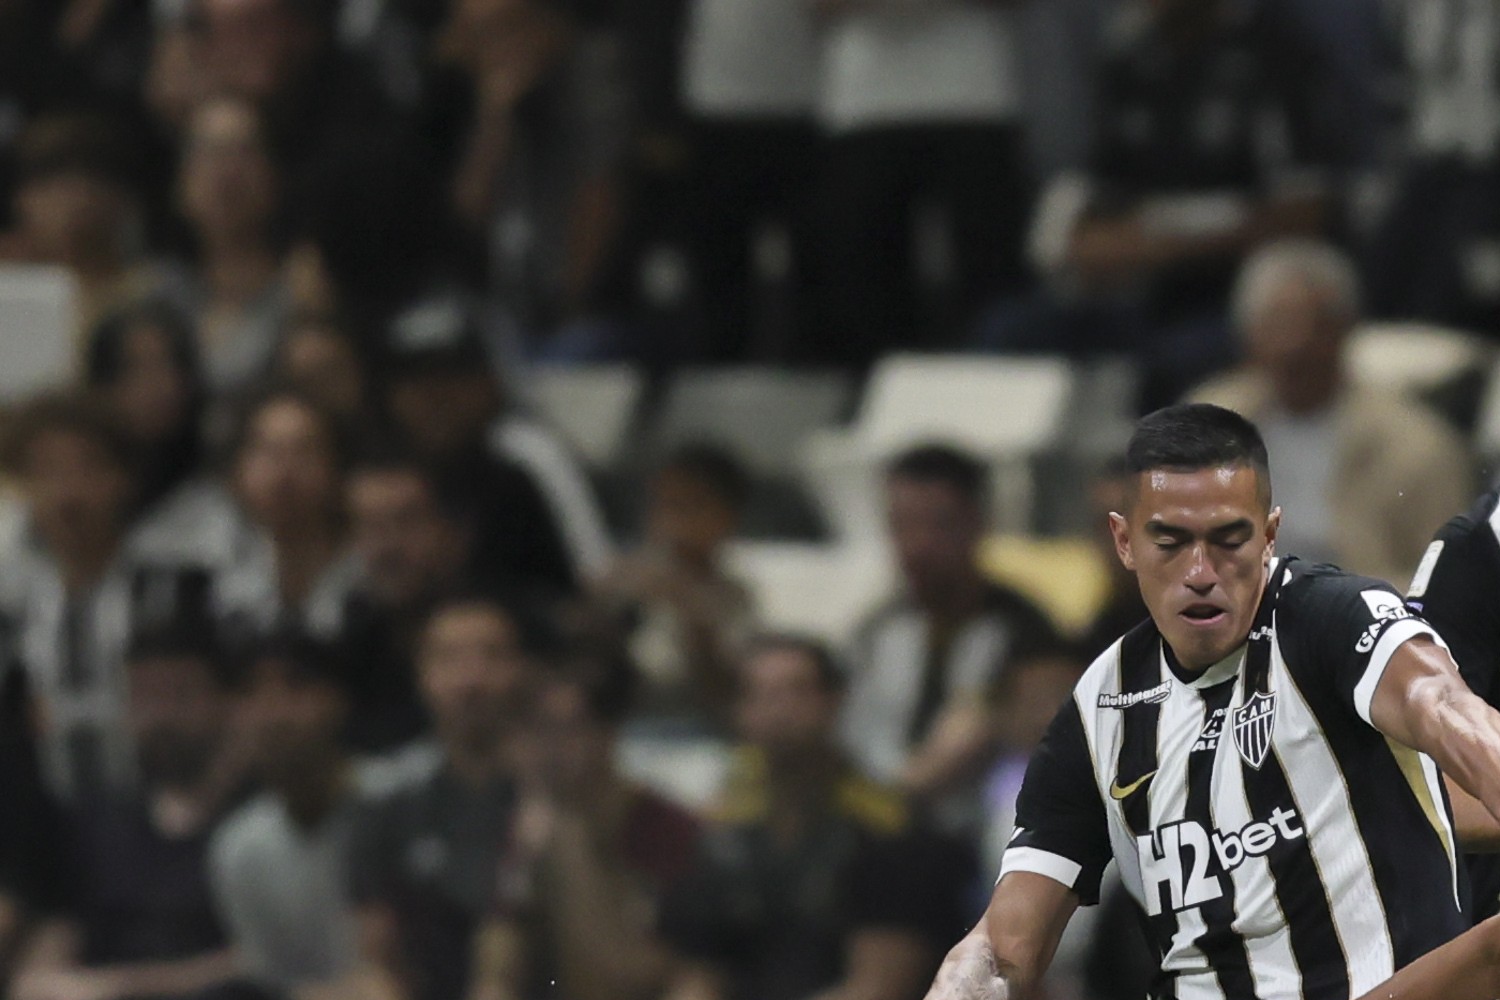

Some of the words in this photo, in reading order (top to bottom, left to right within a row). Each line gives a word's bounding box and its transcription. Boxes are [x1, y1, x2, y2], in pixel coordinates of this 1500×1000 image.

[1238, 698, 1272, 723] CAM
[1191, 737, 1217, 752] AL
[1136, 804, 1304, 917] H2bet
